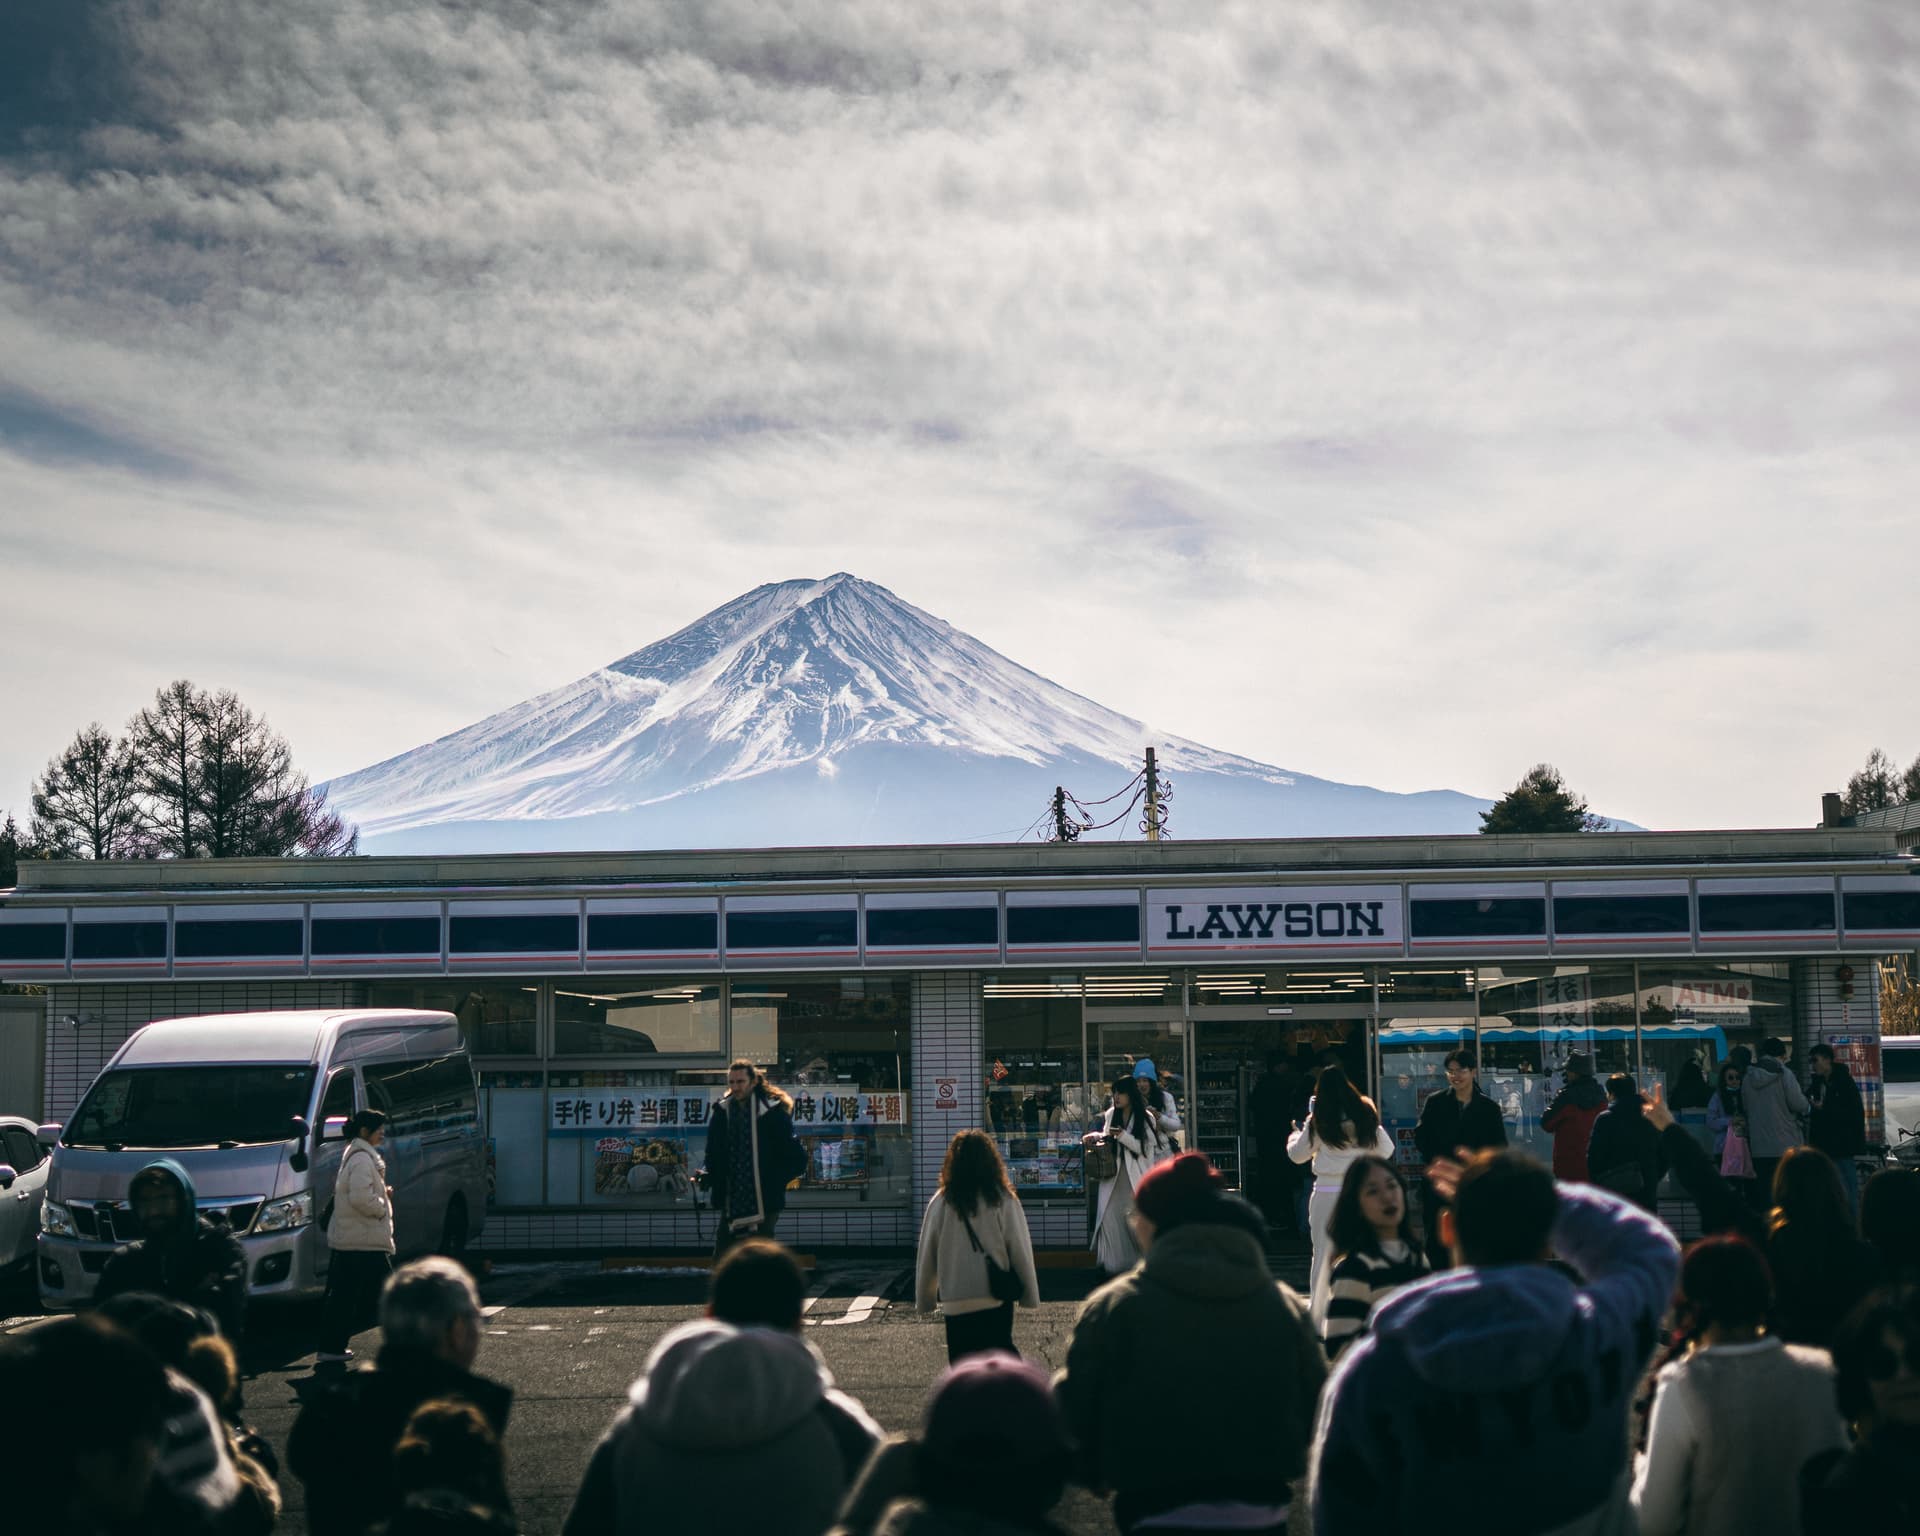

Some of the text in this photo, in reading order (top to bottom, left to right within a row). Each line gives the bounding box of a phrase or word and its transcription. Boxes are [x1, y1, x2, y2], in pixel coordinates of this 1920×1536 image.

[1165, 902, 1384, 939] LAWSON
[1677, 982, 1735, 1004] ATM
[555, 1098, 710, 1125] 手作り弁当調理
